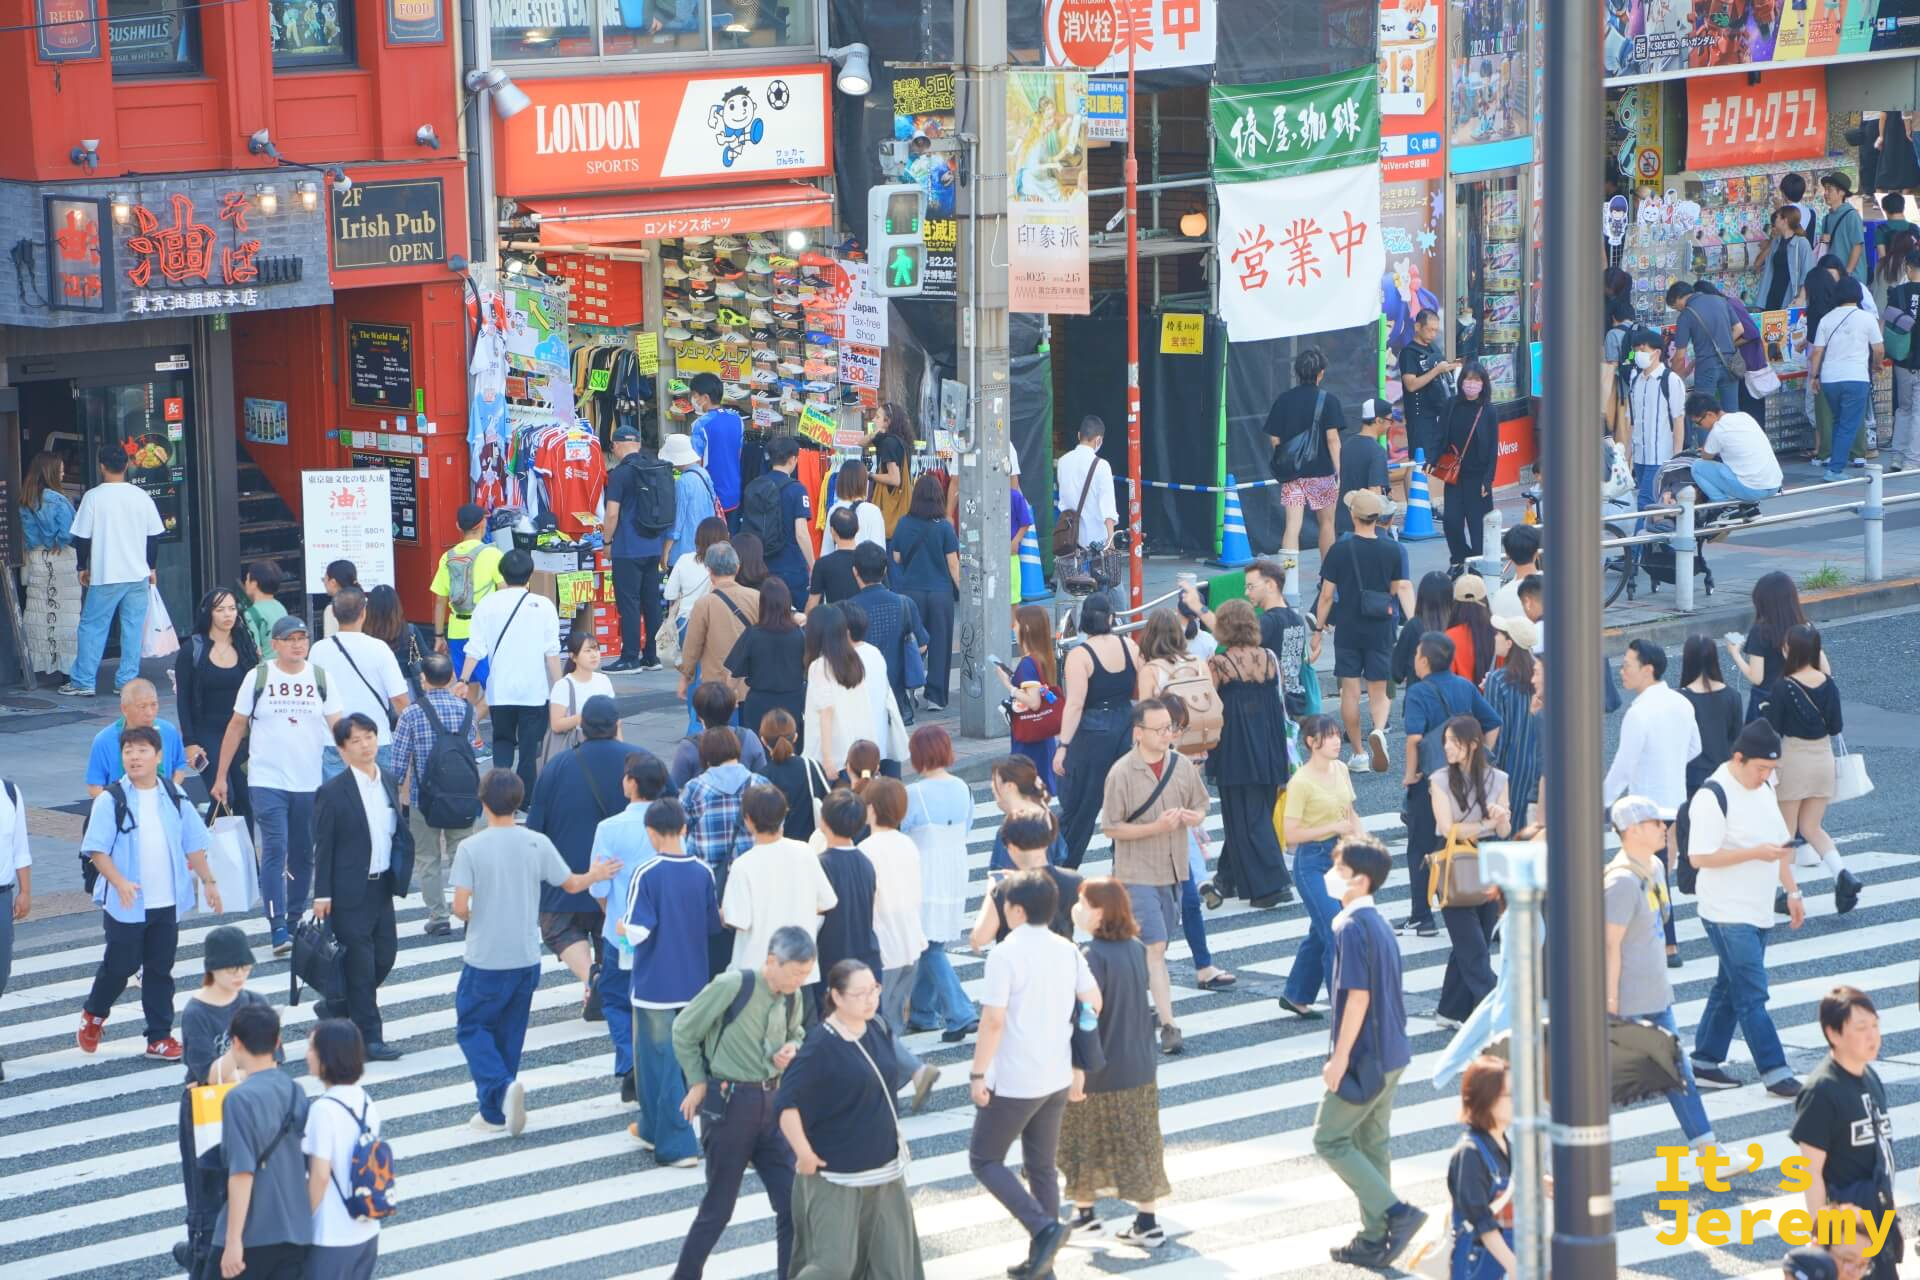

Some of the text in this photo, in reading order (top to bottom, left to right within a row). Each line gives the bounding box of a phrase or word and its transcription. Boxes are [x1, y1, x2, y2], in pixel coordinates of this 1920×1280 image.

[48, 11, 86, 27] BEER
[1063, 10, 1113, 43] 消火栓
[109, 23, 169, 42] BUSHMILLS
[535, 100, 641, 155] LONDON
[775, 148, 806, 158] サッカー
[586, 159, 640, 175] SPORTS
[341, 187, 363, 207] 2F
[340, 210, 436, 240] Irish Pub
[644, 216, 732, 236] ロンドンスポーツ
[129, 191, 261, 288] 油そば
[1017, 224, 1080, 248] 印象派
[389, 242, 435, 263] OPEN
[1230, 210, 1368, 292] 営業中
[131, 288, 258, 314] 東京油組総本店
[852, 301, 879, 315] Japan.
[851, 314, 881, 330] Tax-free
[856, 329, 876, 343] Shop
[849, 366, 864, 381] 80
[268, 682, 315, 698] 1892
